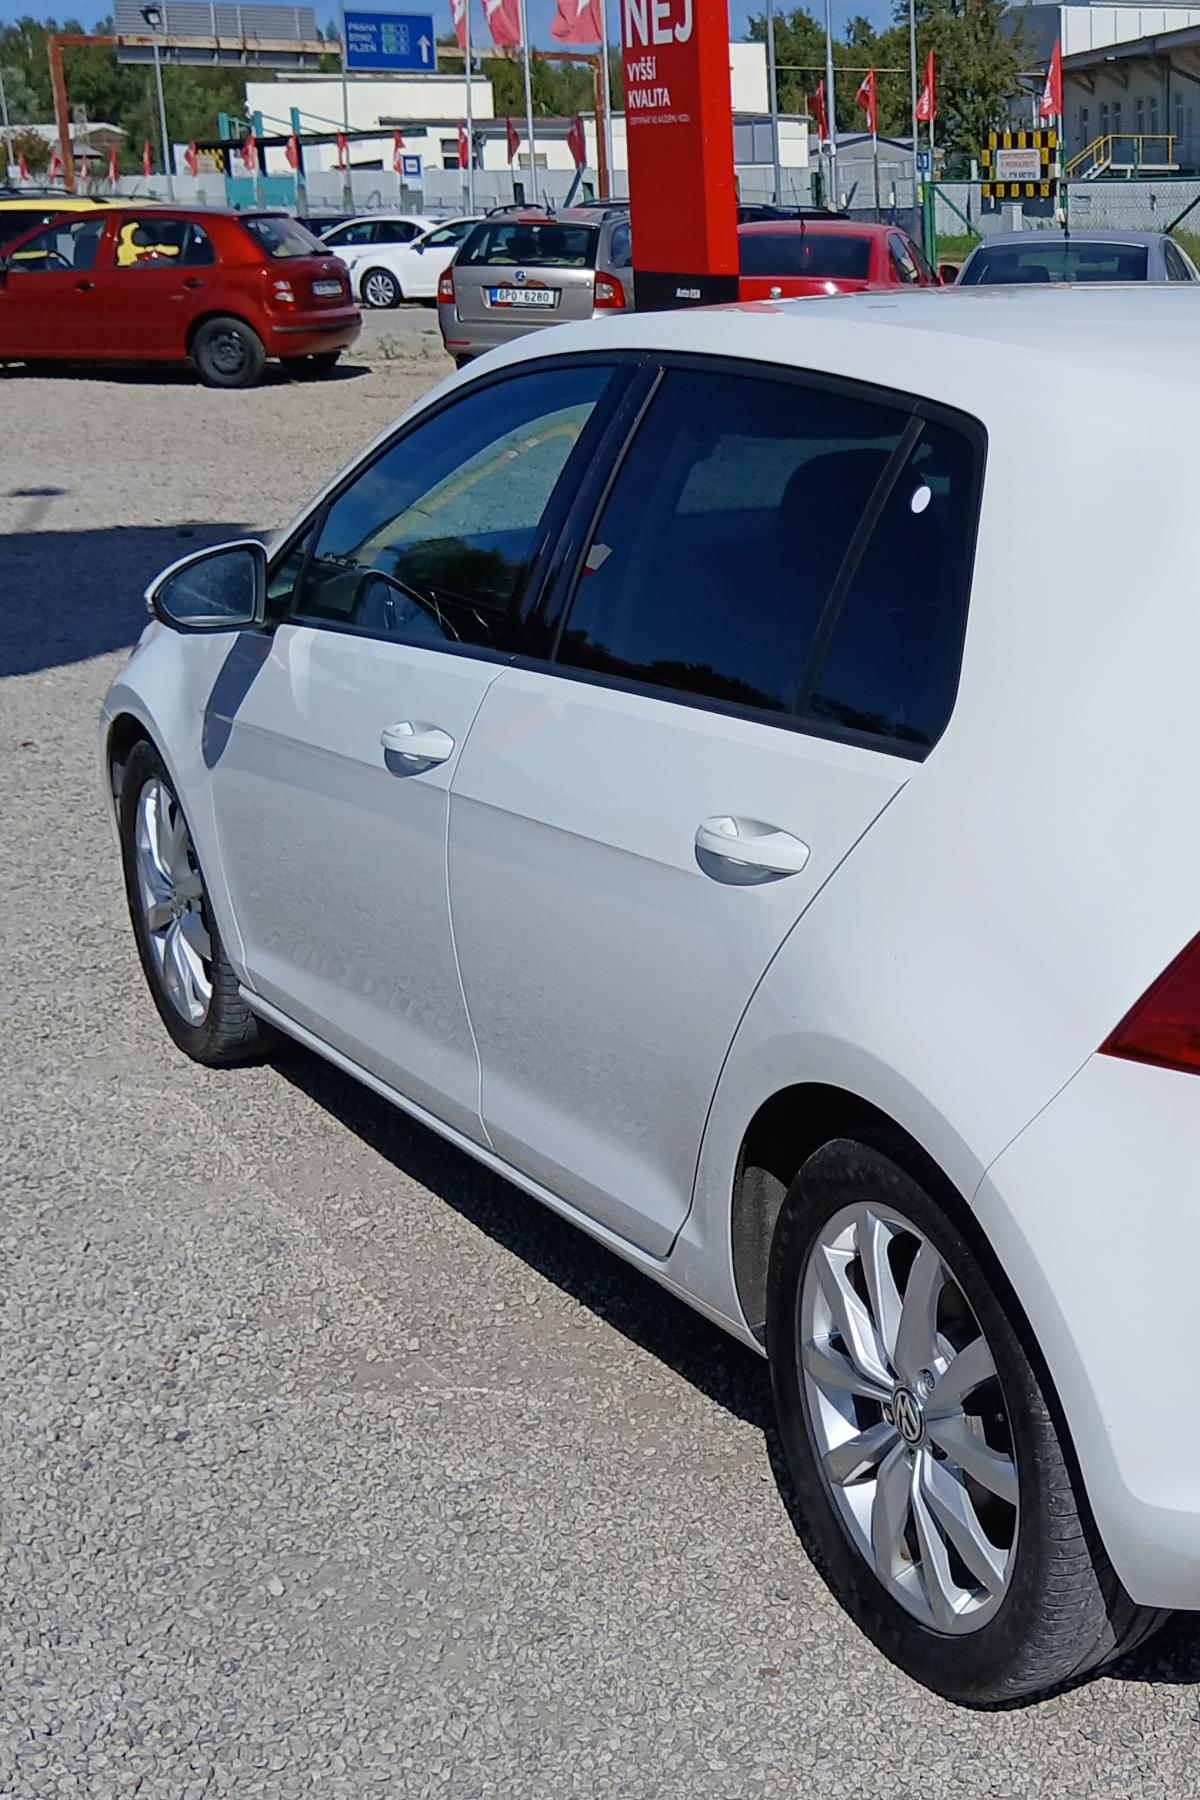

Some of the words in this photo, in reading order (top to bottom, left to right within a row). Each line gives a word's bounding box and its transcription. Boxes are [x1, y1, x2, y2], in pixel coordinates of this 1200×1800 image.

[625, 0, 693, 48] NEJ
[627, 56, 656, 82] VYŠŠÍ
[628, 87, 671, 109] KVALITA
[524, 291, 549, 302] 6280
